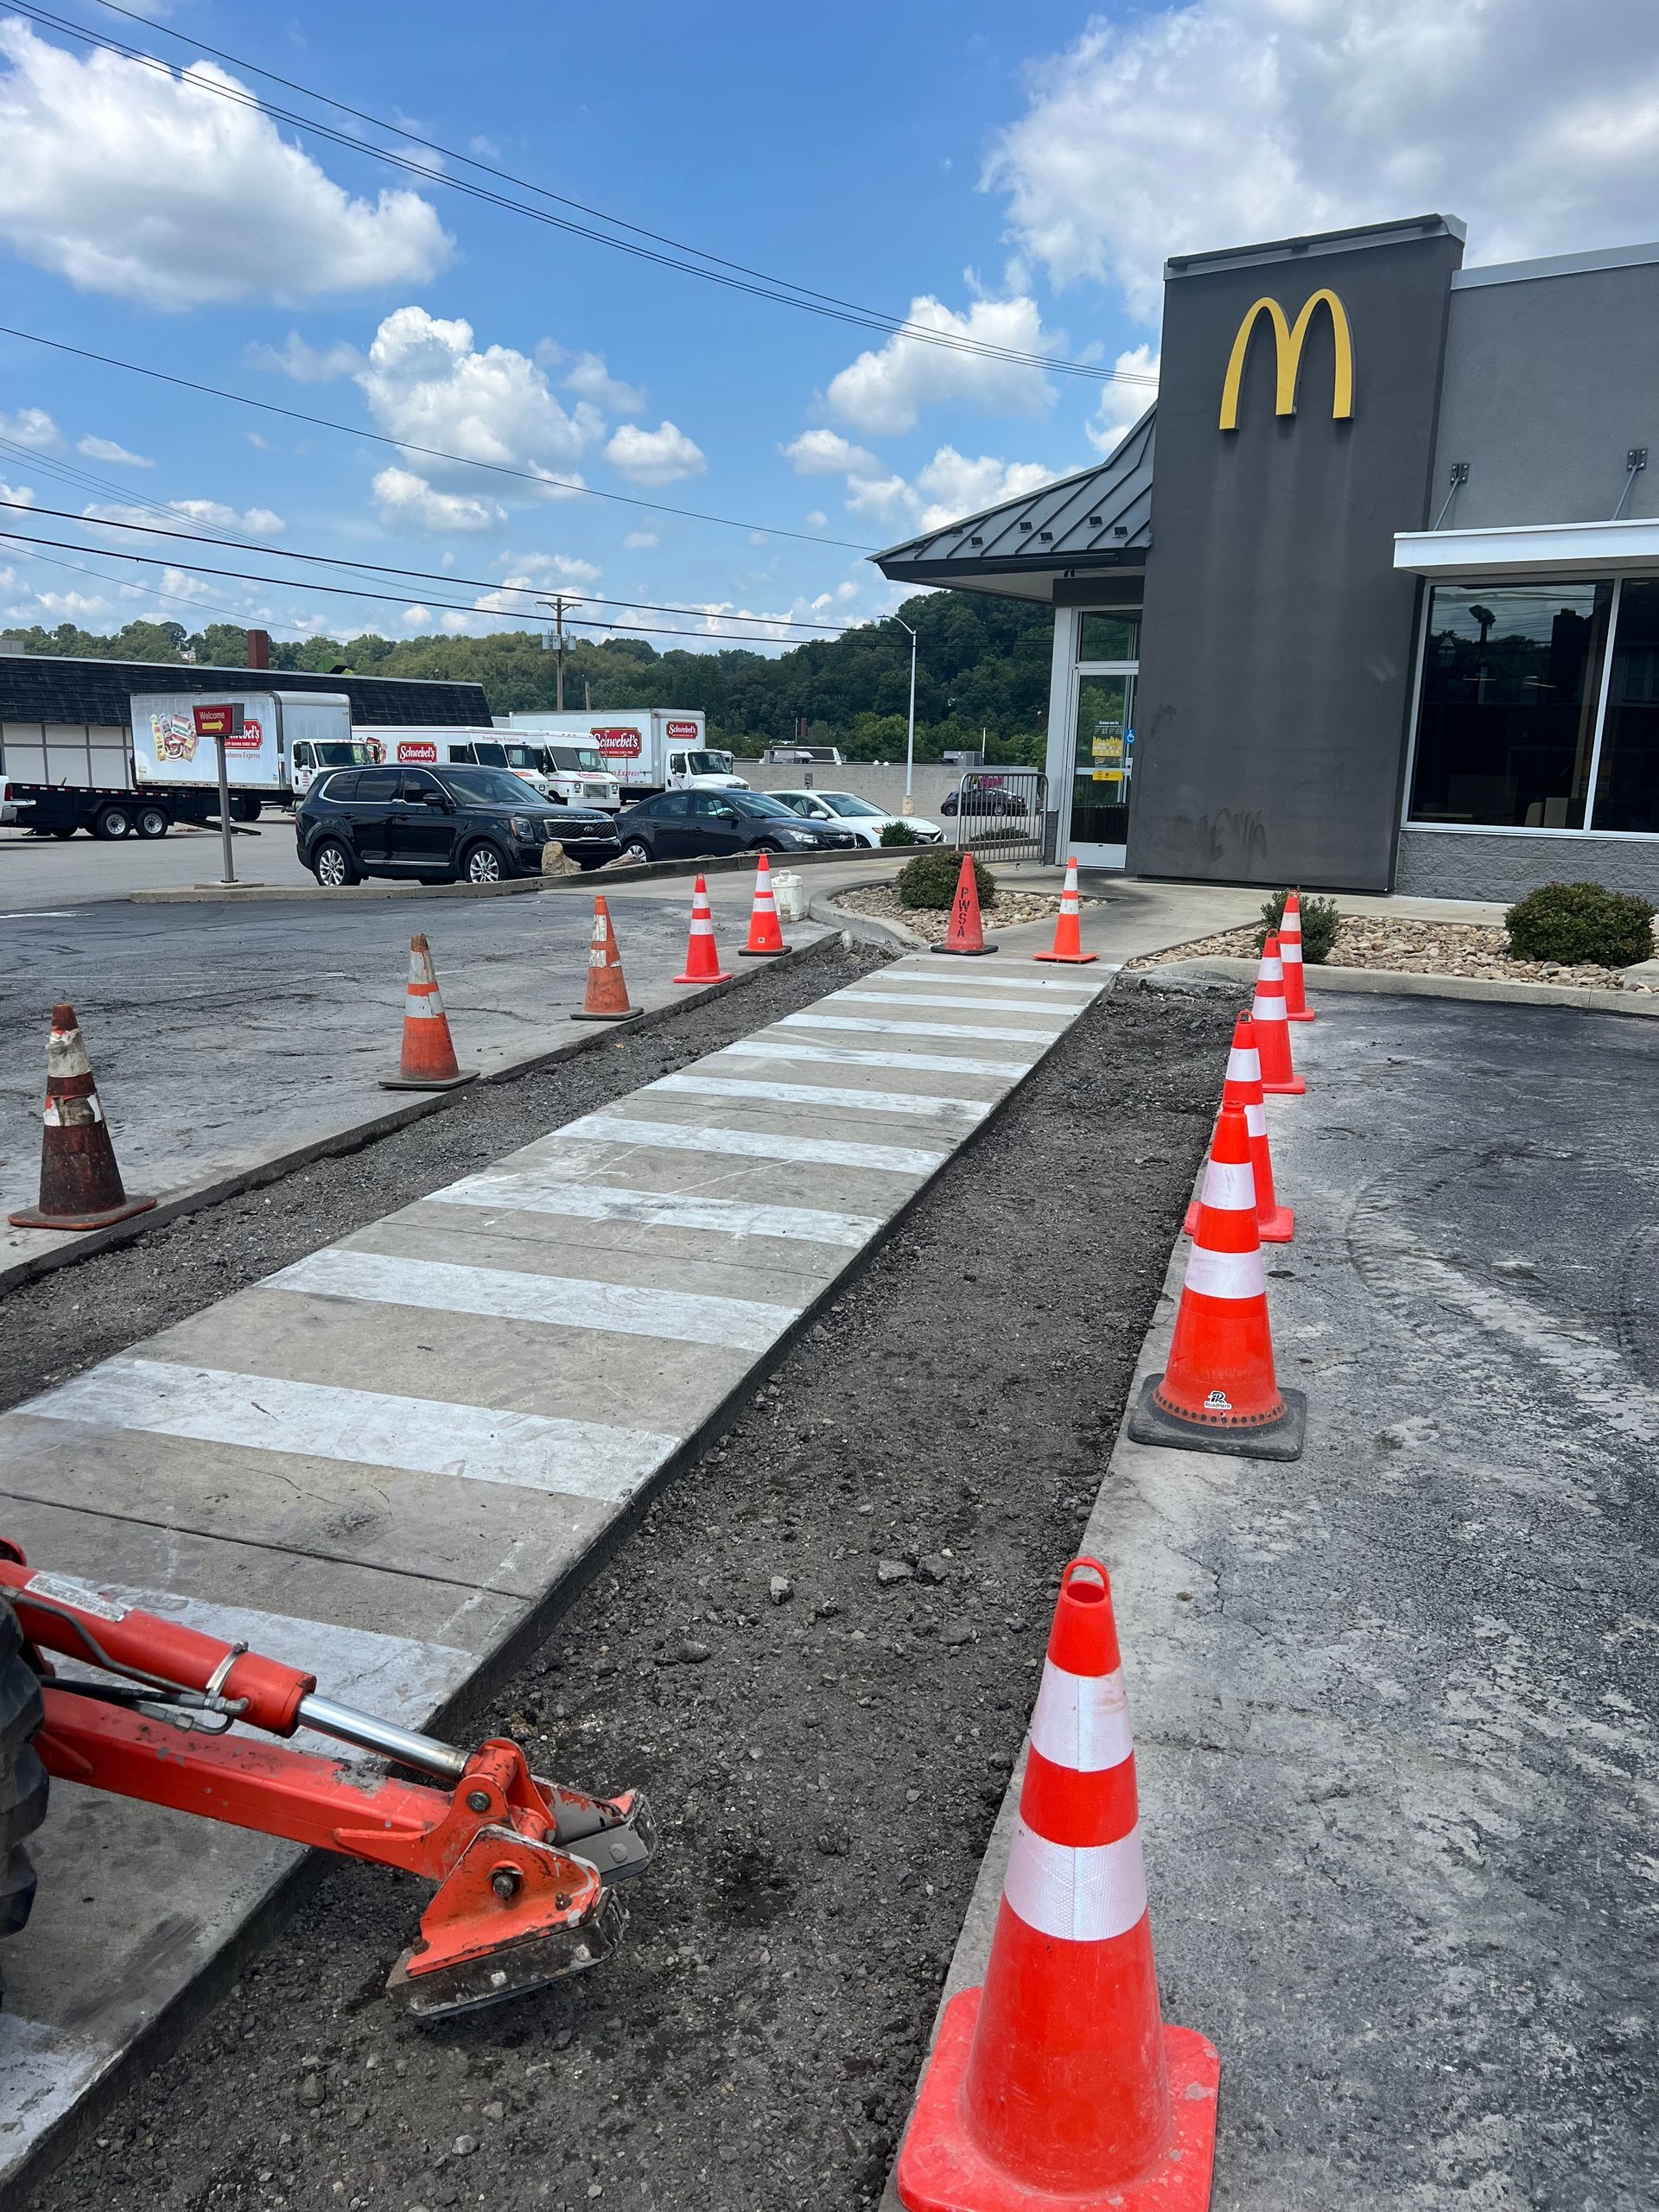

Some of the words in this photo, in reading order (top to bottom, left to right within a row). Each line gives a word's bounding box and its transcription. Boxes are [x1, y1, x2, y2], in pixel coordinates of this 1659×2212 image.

[200, 711, 226, 720] Welcome
[668, 724, 696, 734] Schwebel's
[399, 745, 435, 760] Schwebel's
[957, 887, 970, 938] PWSA
